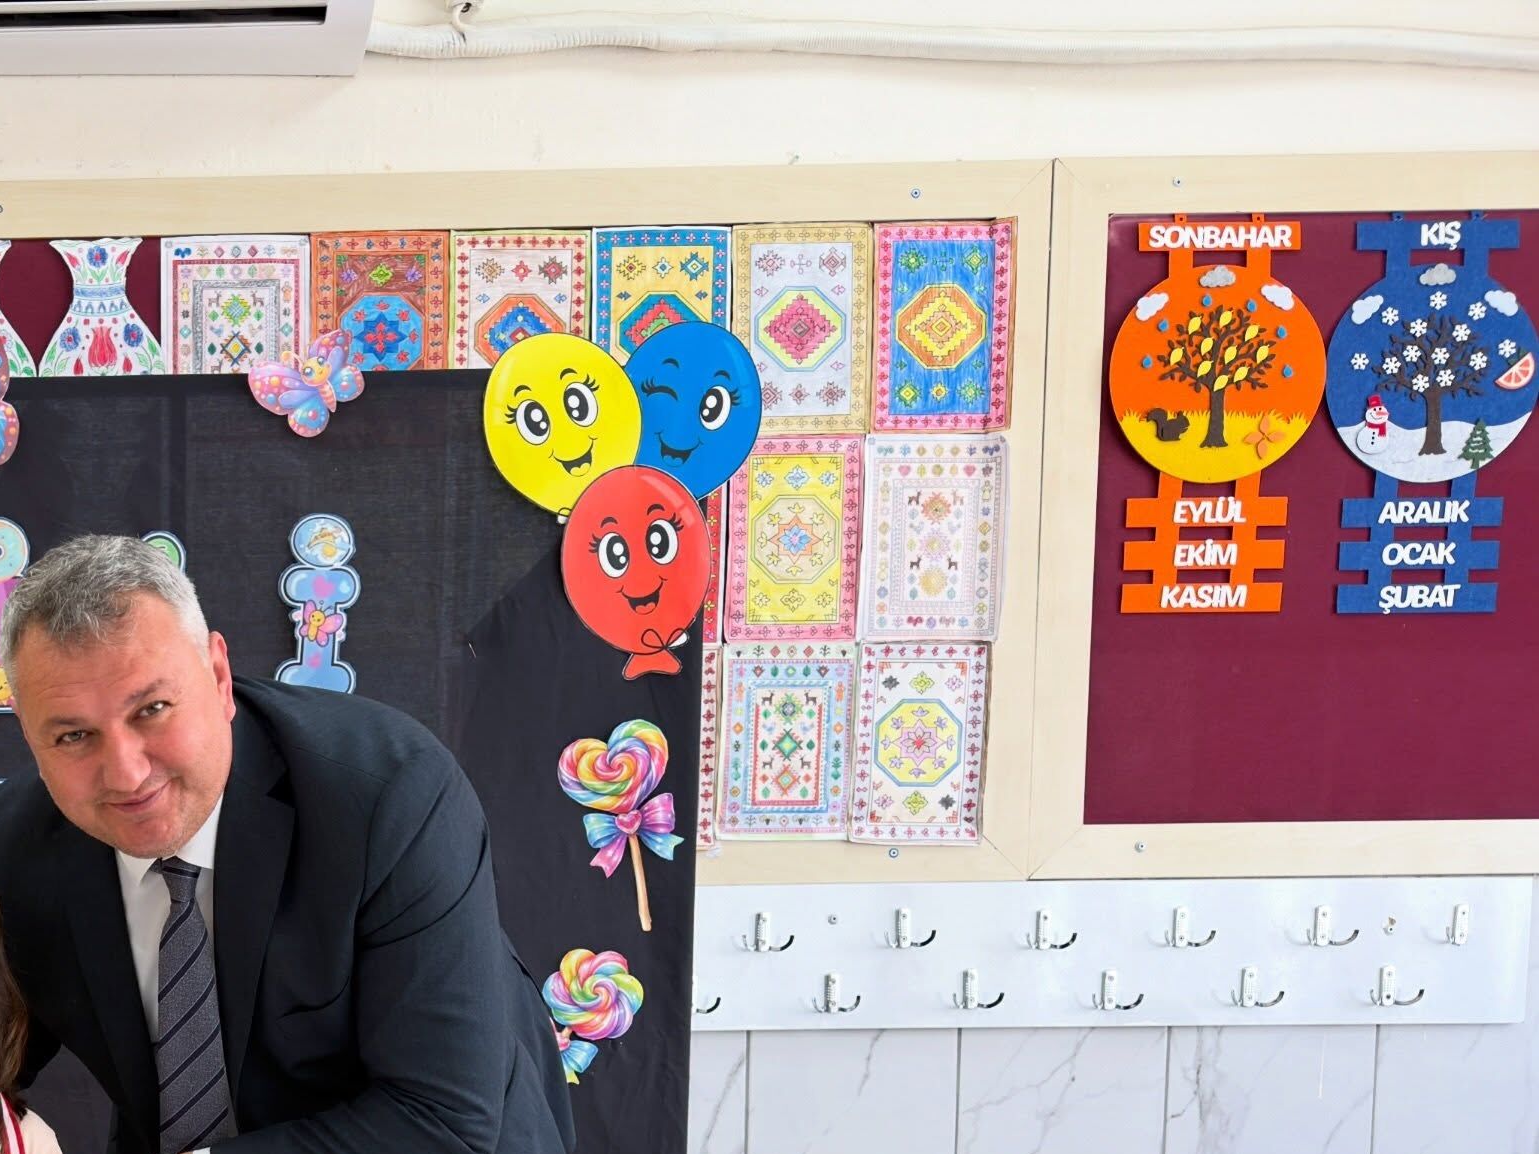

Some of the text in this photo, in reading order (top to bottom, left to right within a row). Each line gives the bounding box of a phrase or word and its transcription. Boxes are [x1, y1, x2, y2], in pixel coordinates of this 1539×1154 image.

[1148, 224, 1293, 249] SONBAHAR
[1419, 220, 1461, 251] KIŞ
[1172, 496, 1247, 524] EYLÜL
[1377, 500, 1470, 524] ARALIK
[1173, 538, 1238, 567] EKİM
[1381, 542, 1457, 567] OCAK
[1160, 584, 1248, 609] KASIM
[1378, 583, 1461, 615] ŞUBAT
